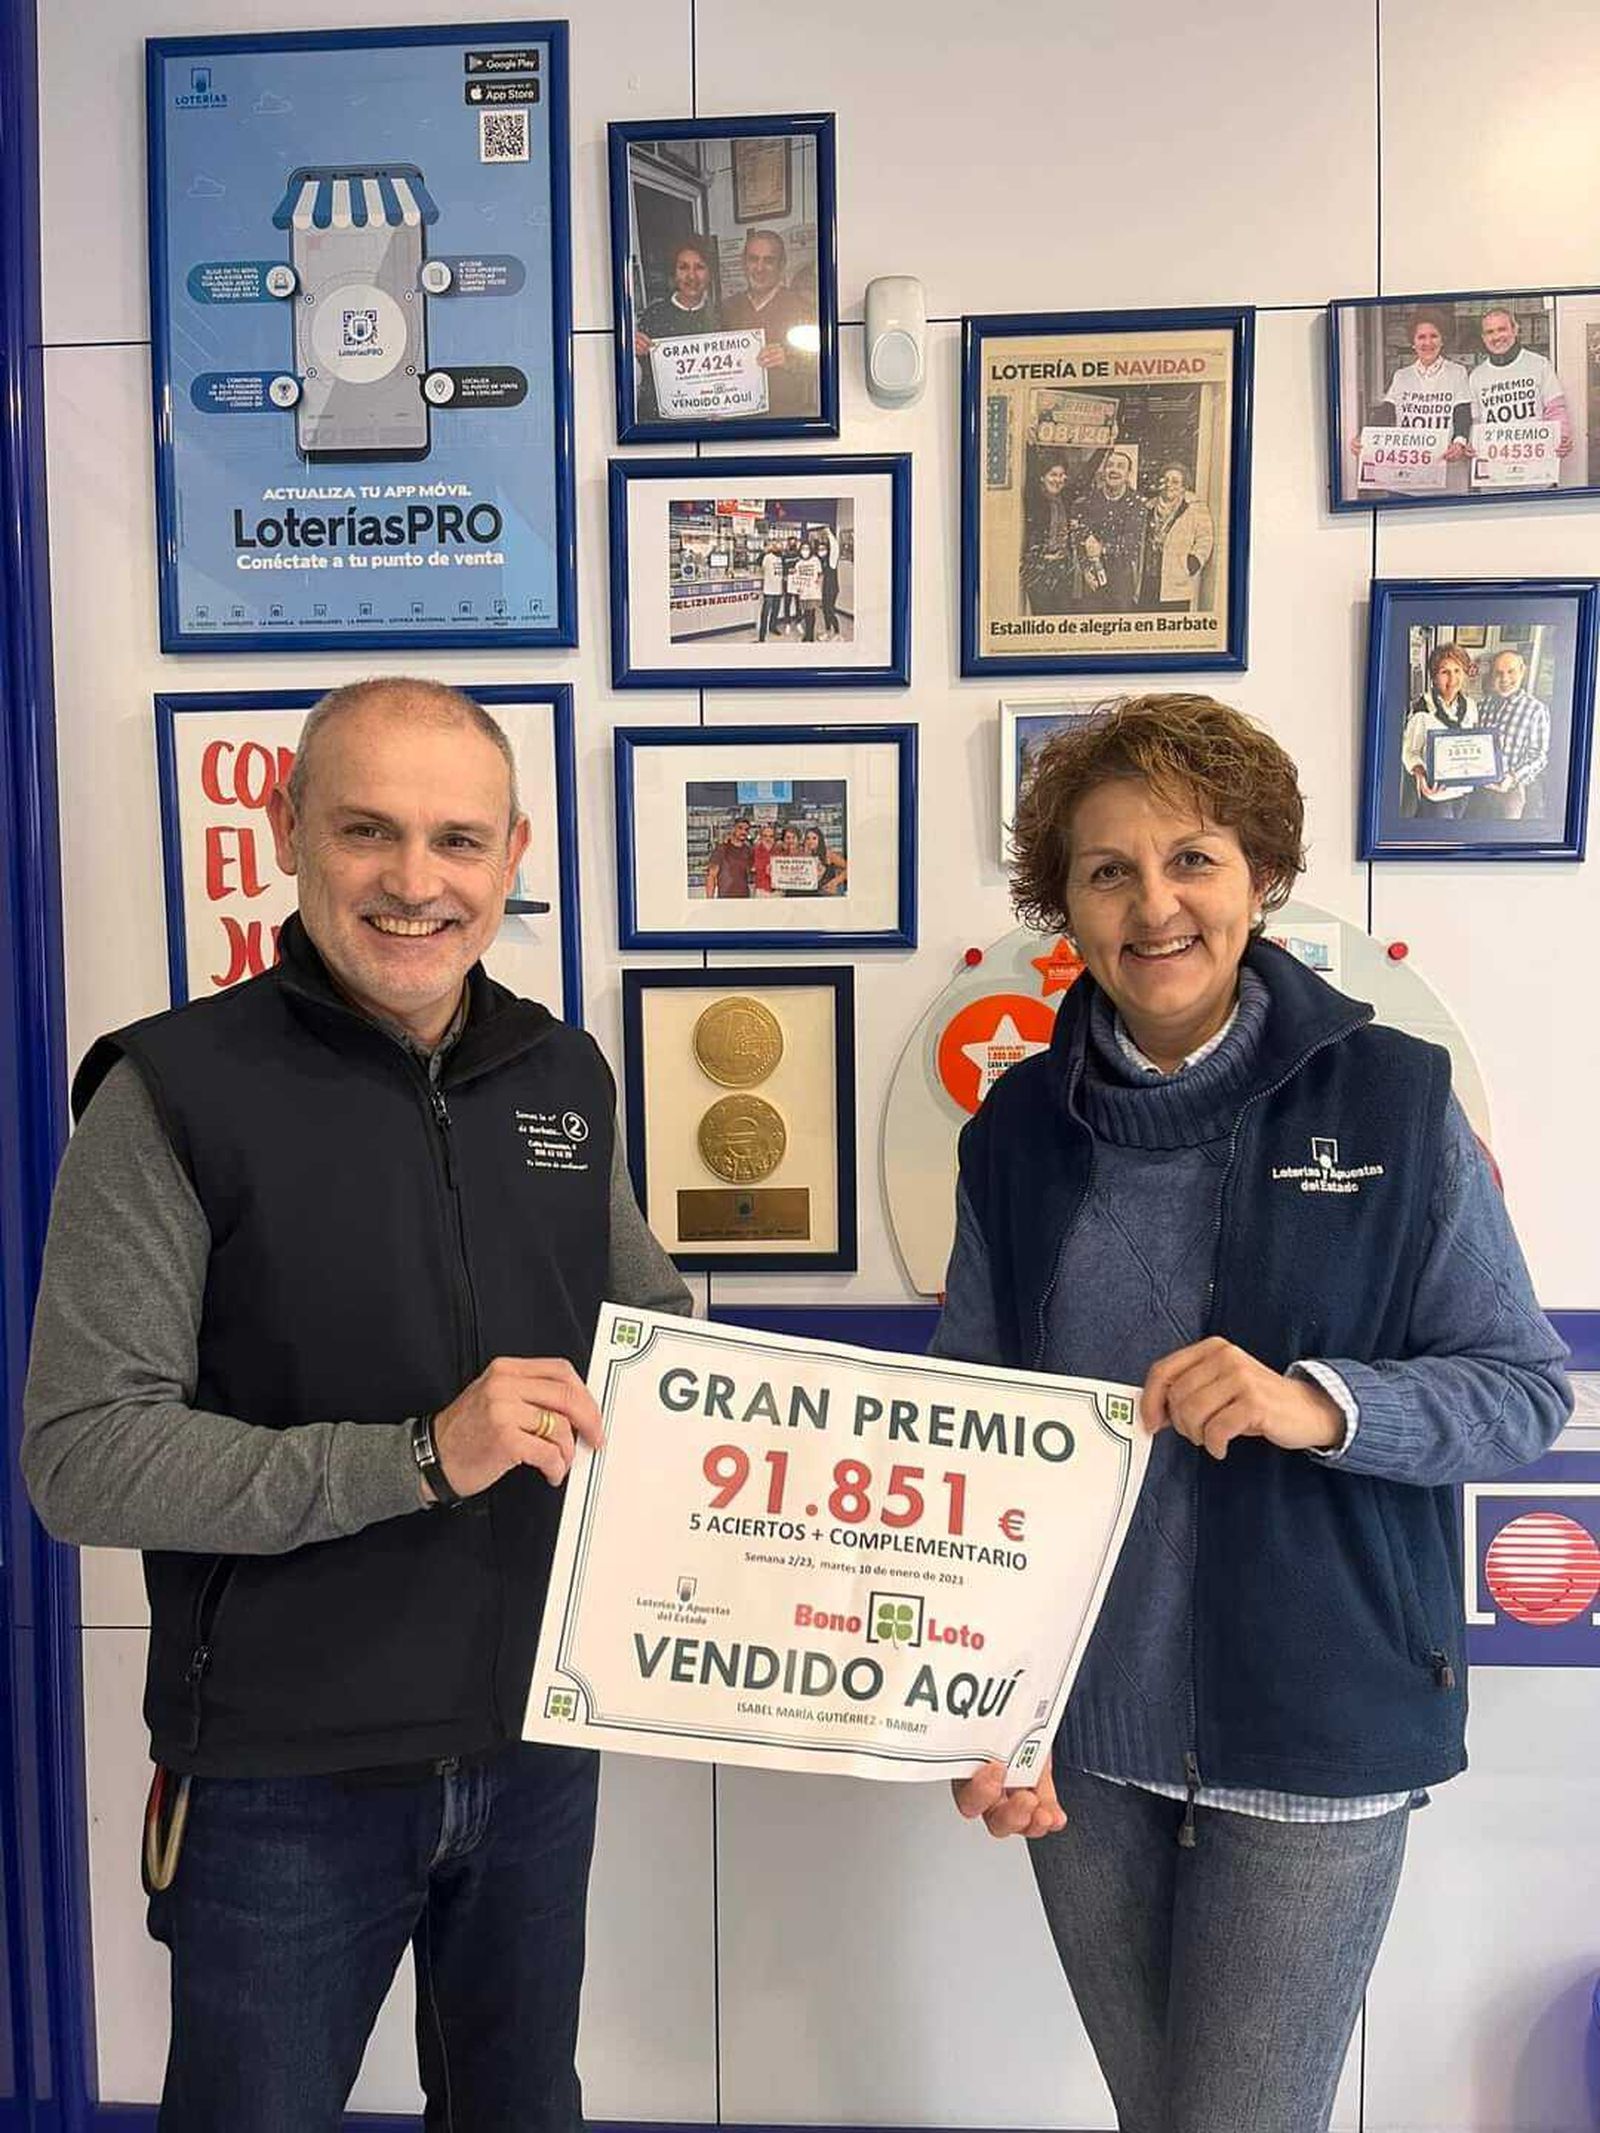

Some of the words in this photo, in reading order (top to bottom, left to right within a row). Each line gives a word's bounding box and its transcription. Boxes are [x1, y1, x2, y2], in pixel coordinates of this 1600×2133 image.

[486, 59, 516, 70] Google
[517, 58, 536, 69] Play
[485, 90, 506, 100] App
[507, 89, 534, 99] Store
[662, 344, 700, 358] GRAN
[703, 338, 751, 353] PREMIO
[676, 354, 733, 375] 37.424
[991, 358, 1077, 380] LOTERÍA
[1081, 361, 1110, 377] DE
[1114, 358, 1206, 377] NAVIDAD
[1491, 378, 1535, 393] PREMIO
[671, 397, 721, 408] VENDIDO
[1411, 392, 1453, 401] PREMIO
[1481, 389, 1536, 407] VENDIDO
[1401, 404, 1452, 414] VENDIDO
[1384, 434, 1437, 447] PREMIO
[1496, 428, 1549, 440] PREMIO
[1375, 449, 1432, 464] 04536
[1487, 443, 1545, 459] 04536
[262, 486, 356, 500] ACTUALIZA
[360, 486, 380, 498] TU
[384, 485, 416, 498] APP
[418, 481, 472, 497] MÓVIL
[233, 503, 504, 549] LoteríasPRO
[236, 553, 328, 570] Conéctate
[332, 557, 344, 568] a
[349, 554, 368, 568] tu
[371, 553, 423, 570] punto
[428, 551, 448, 566] de
[454, 550, 505, 566] venta
[990, 620, 1055, 636] Estallido
[1058, 619, 1077, 634] de
[1135, 620, 1153, 632] en
[1156, 616, 1218, 631] Barbate
[205, 826, 271, 901] EL
[211, 916, 280, 988] JU
[568, 1115, 582, 1137] 2
[1329, 1165, 1384, 1181] Apuestas
[1301, 1179, 1319, 1192] del
[1320, 1179, 1359, 1193] Estado
[658, 1367, 830, 1430] GRAN
[853, 1395, 1076, 1463] PREMIO
[702, 1444, 967, 1537] 91.851
[998, 1508, 1027, 1543] €
[689, 1513, 702, 1531] 5
[706, 1514, 807, 1542] ACIERTOS
[811, 1528, 824, 1542] +
[829, 1526, 1028, 1571] COMPLEMENTARIO
[744, 1551, 786, 1565] Semana
[787, 1555, 815, 1570] 2/23,
[820, 1559, 856, 1574] martes
[859, 1564, 872, 1575] 10
[873, 1564, 887, 1576] de
[889, 1568, 921, 1580] enero
[922, 1569, 936, 1581] de
[938, 1573, 964, 1586] 2023
[657, 1611, 672, 1622] del
[673, 1612, 707, 1625] Estado
[686, 1602, 730, 1616] Apuestas
[793, 1602, 862, 1634] Bono
[927, 1618, 985, 1651] Loto
[633, 1632, 885, 1701] VENDIDO
[904, 1664, 1026, 1719] AQUÍ
[737, 1702, 772, 1717] ISABEL
[775, 1706, 814, 1721] MARÍA
[816, 1710, 877, 1726] GUTIÉRREZ
